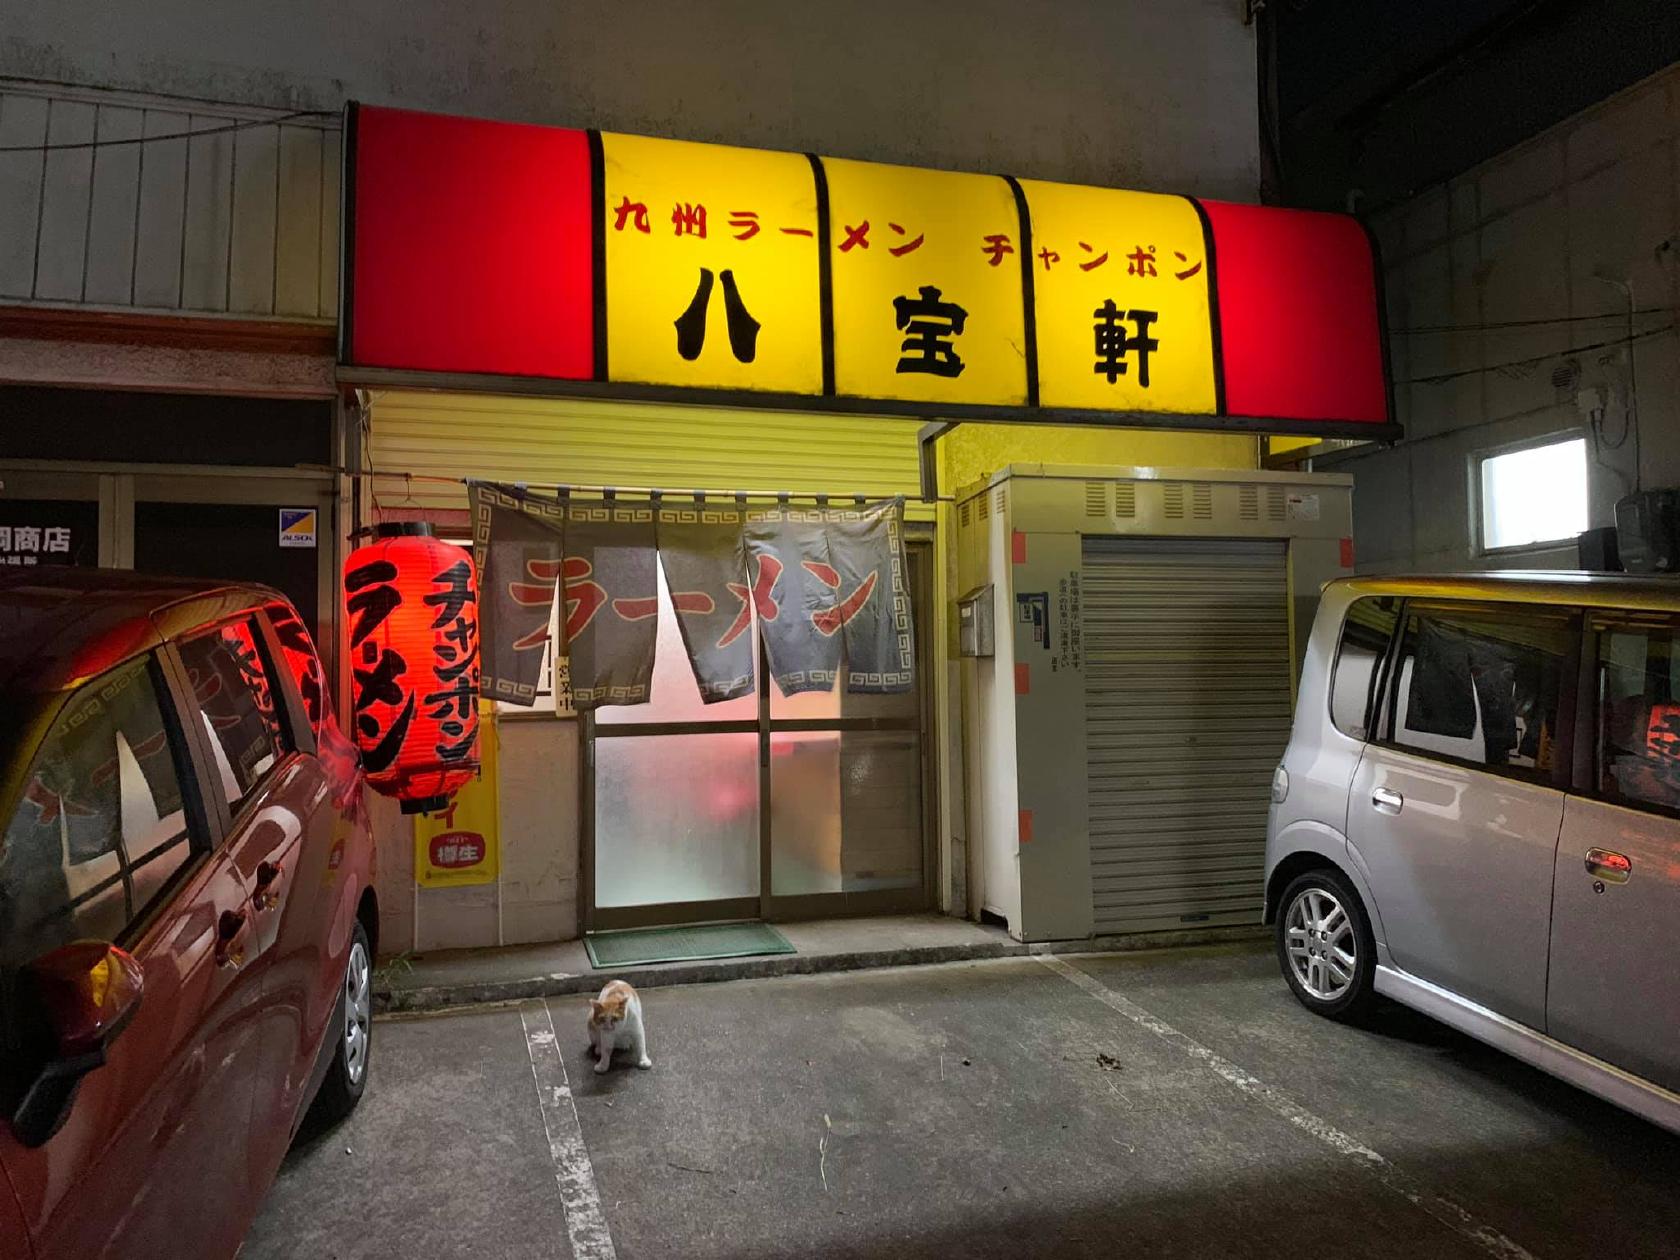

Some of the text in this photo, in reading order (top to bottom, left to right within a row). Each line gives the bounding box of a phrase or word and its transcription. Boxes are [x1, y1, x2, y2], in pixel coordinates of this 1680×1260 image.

[613, 196, 1202, 281] 九州ラーメン チャンポン
[674, 267, 1160, 388] 八宝軒
[423, 560, 479, 761] チャンポン
[509, 553, 878, 651] ラーメン
[344, 560, 416, 773] ラーメン
